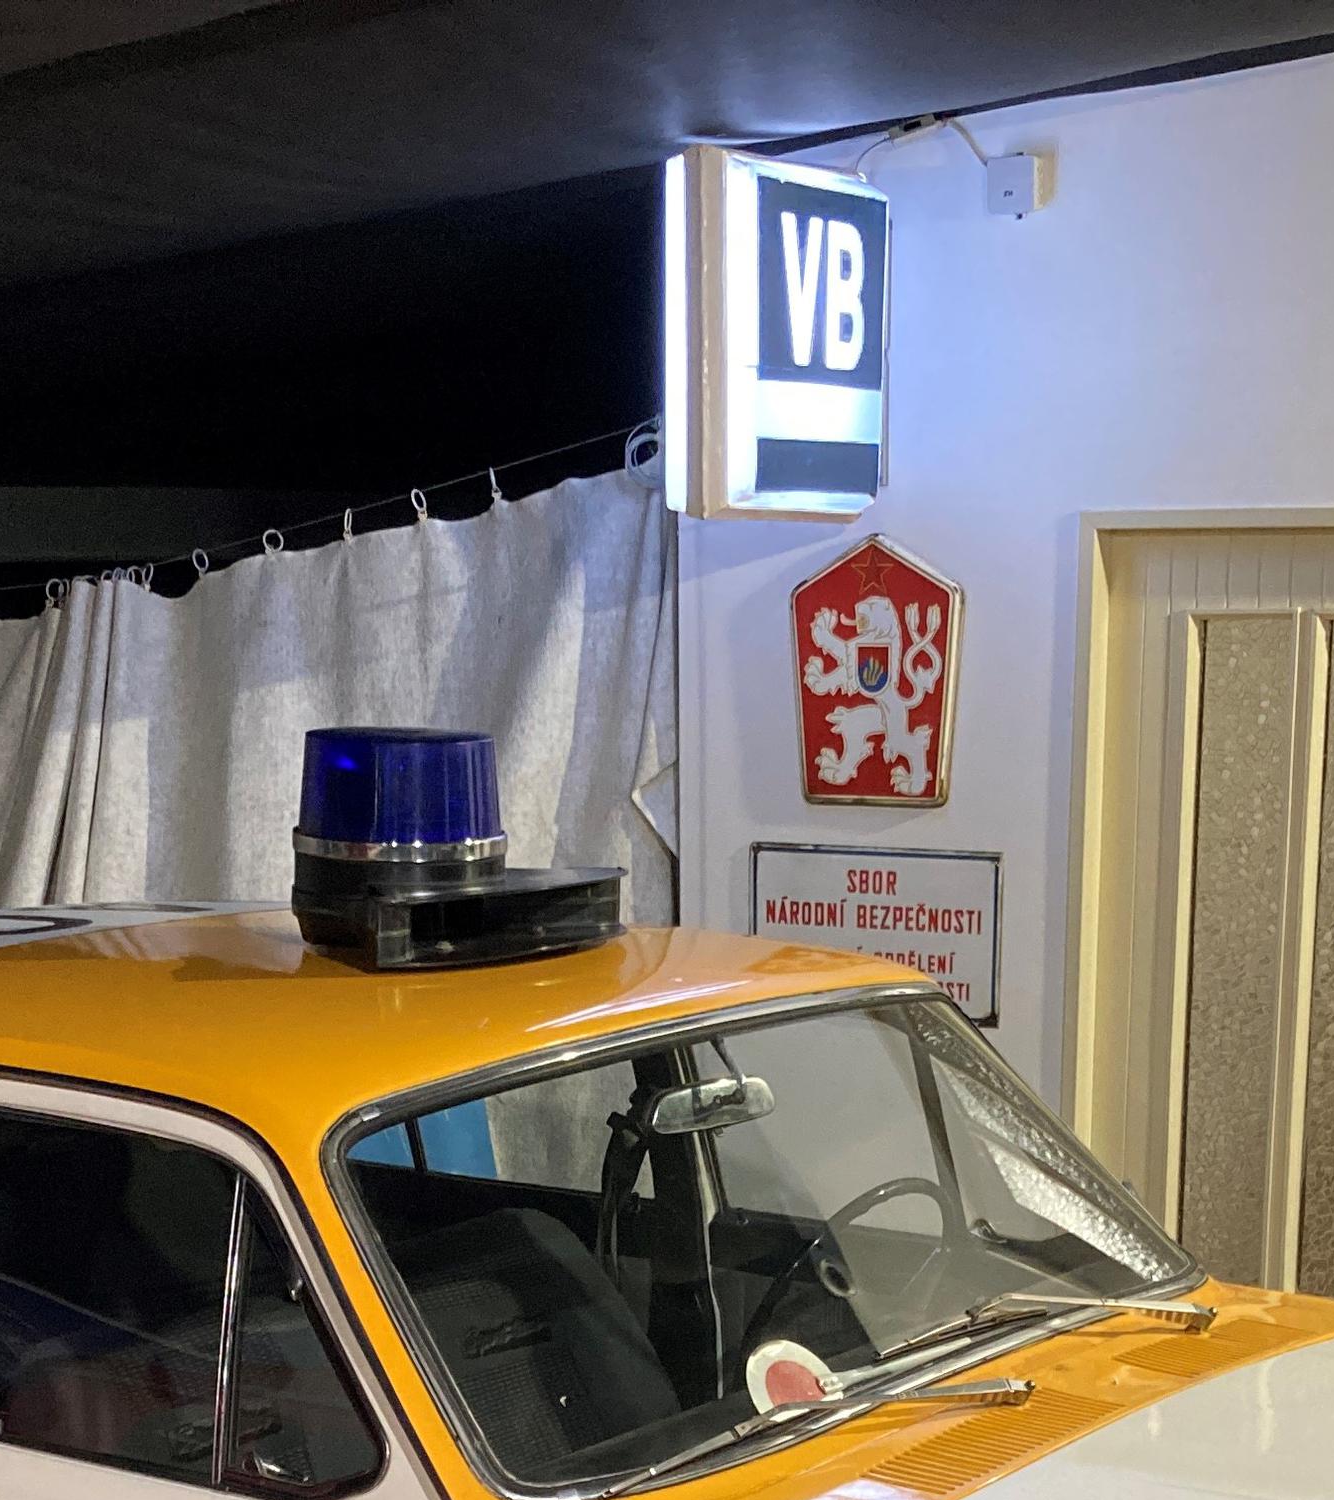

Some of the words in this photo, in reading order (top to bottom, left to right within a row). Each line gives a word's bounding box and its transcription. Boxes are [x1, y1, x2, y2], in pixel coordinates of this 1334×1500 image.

[780, 211, 866, 371] VB
[846, 869, 897, 896] SBOR
[765, 896, 847, 929] NÁRODNÍ
[856, 904, 982, 935] BEZPEČNOSTI
